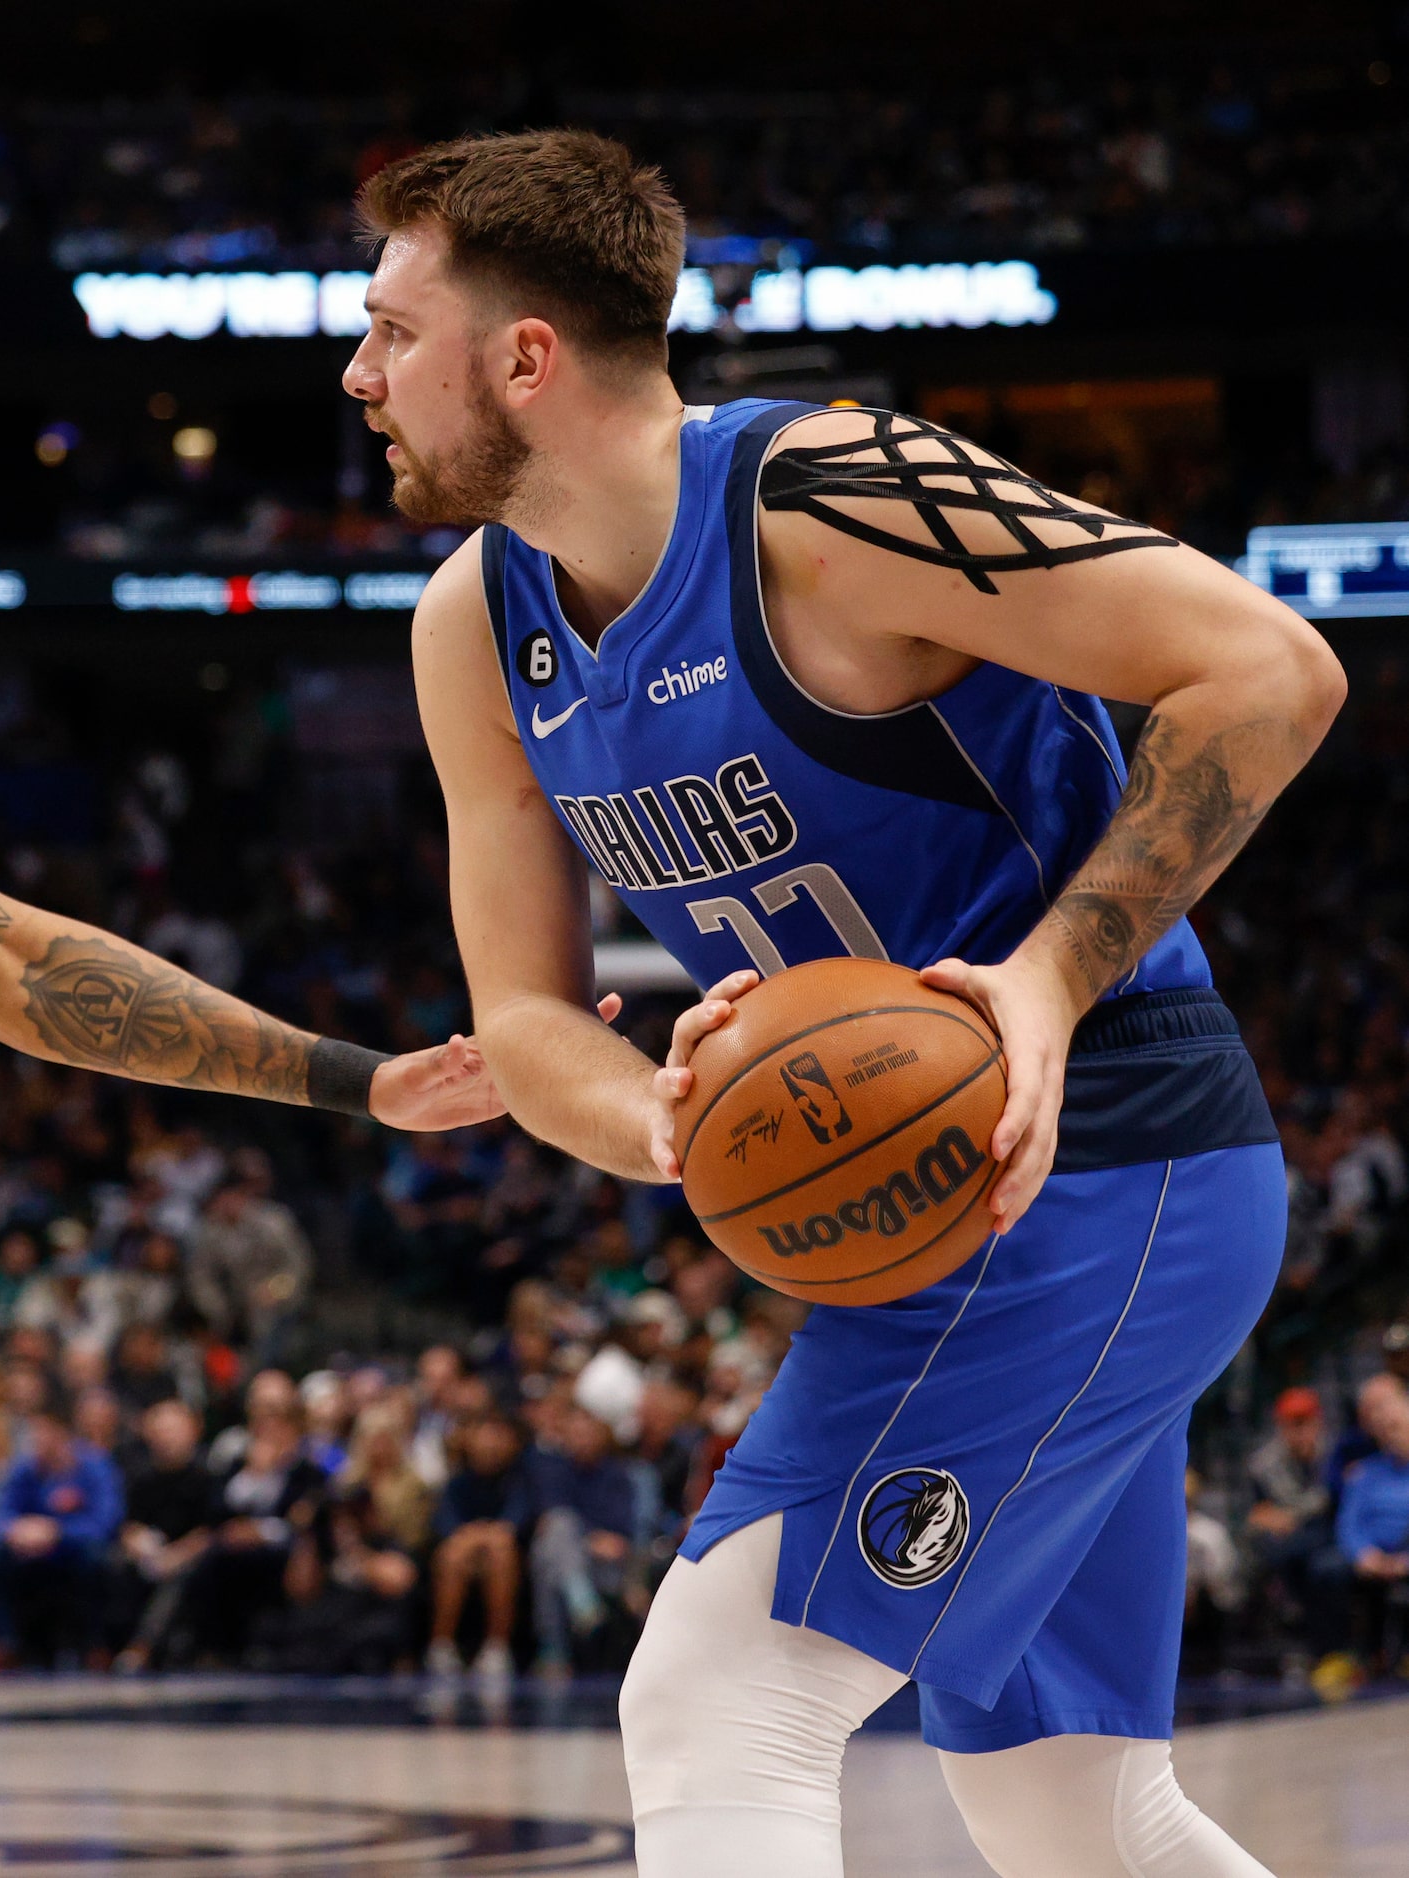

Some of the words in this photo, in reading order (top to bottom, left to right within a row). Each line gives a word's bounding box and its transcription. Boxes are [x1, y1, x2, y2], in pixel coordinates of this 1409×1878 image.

[529, 637, 553, 681] 6
[646, 654, 729, 706] chime
[554, 753, 799, 892] DALLAS
[756, 1124, 987, 1259] Wilson
